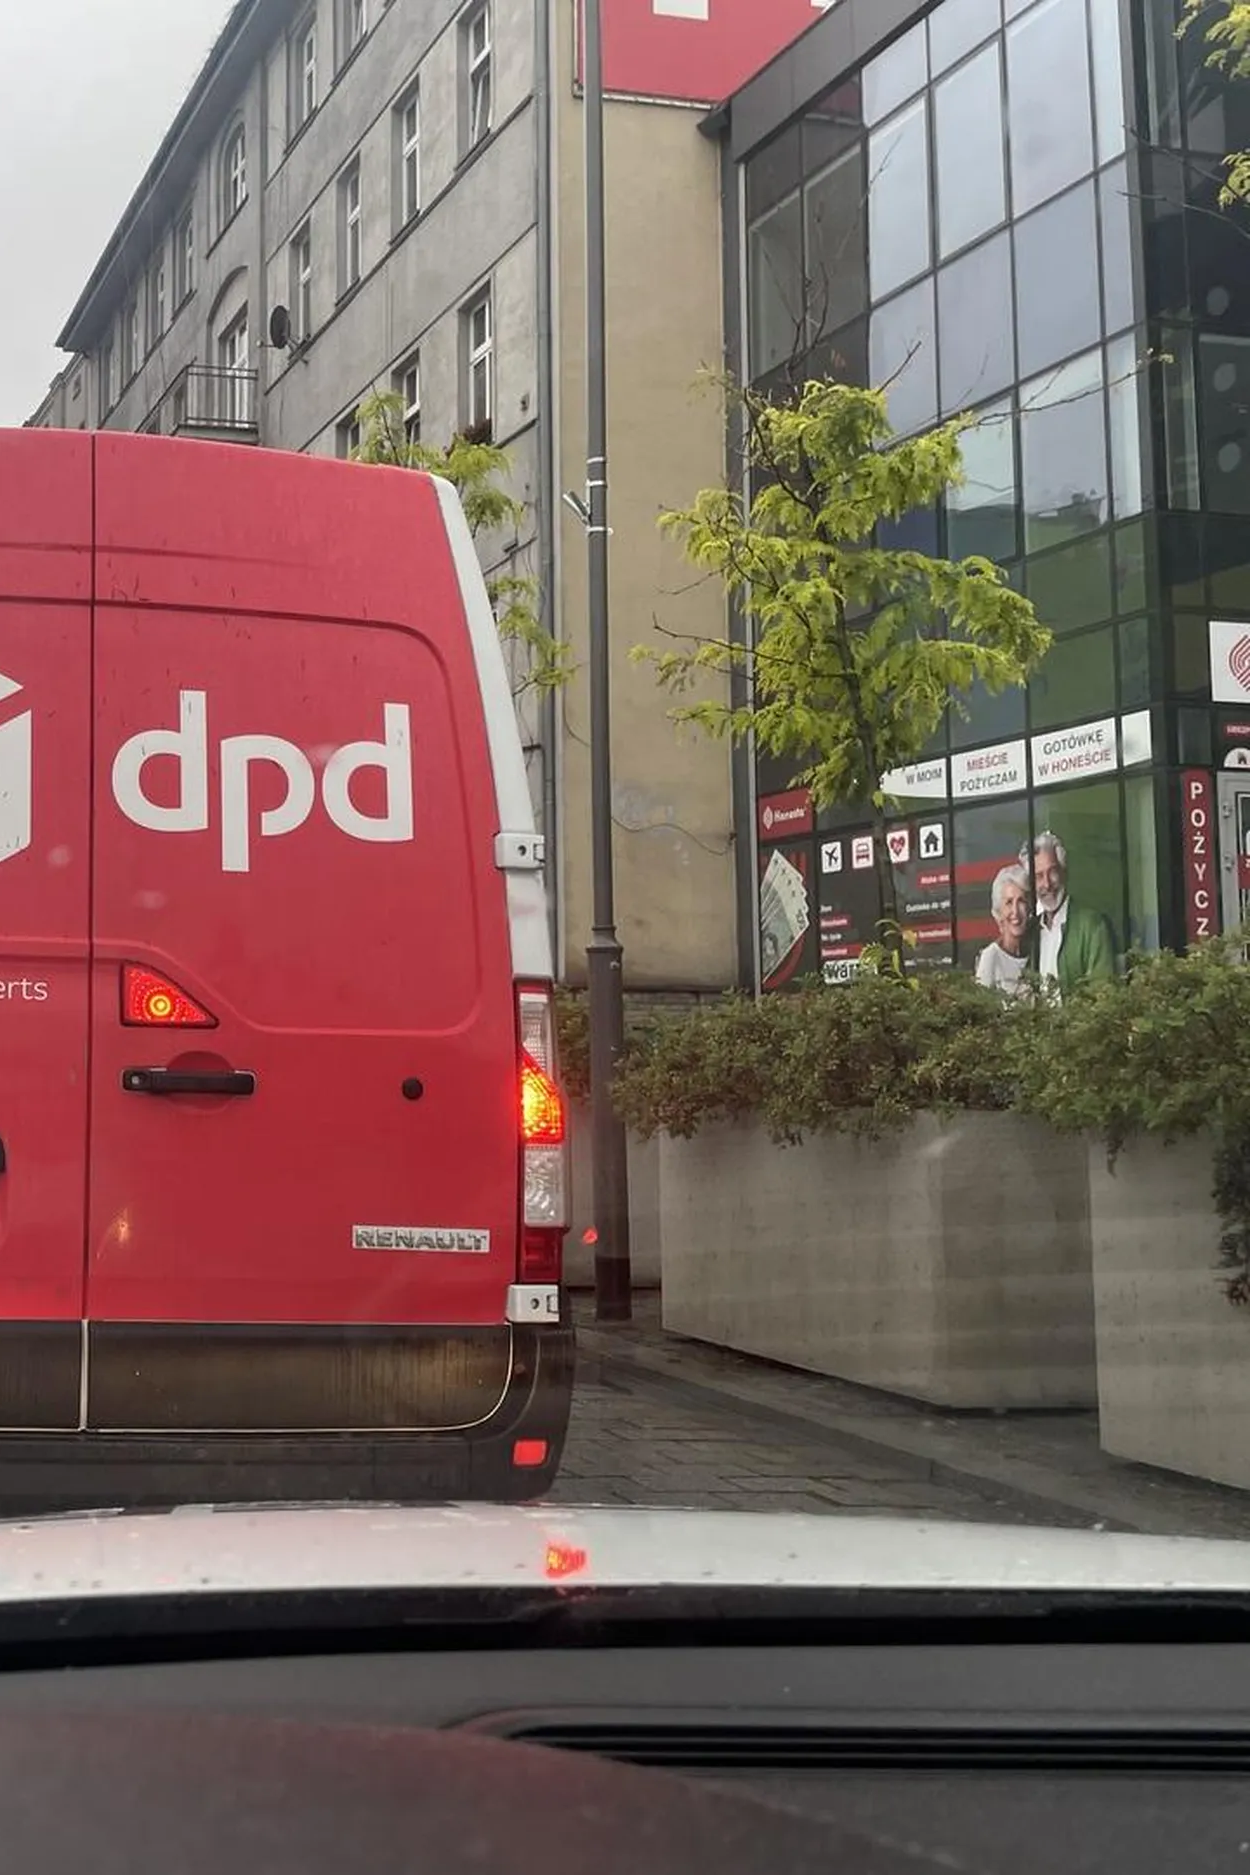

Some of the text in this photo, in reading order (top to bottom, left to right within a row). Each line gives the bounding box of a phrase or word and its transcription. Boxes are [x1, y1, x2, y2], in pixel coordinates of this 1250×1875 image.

[1043, 730, 1104, 755] GOTÓWKĘ
[966, 751, 1009, 772] MIEŚCIE
[1051, 748, 1112, 774] HONEŚCIE
[111, 689, 414, 872] dpd
[916, 767, 943, 785] MOIM
[960, 771, 1018, 793] POŻYCZAM
[354, 1228, 488, 1251] RENAULT
